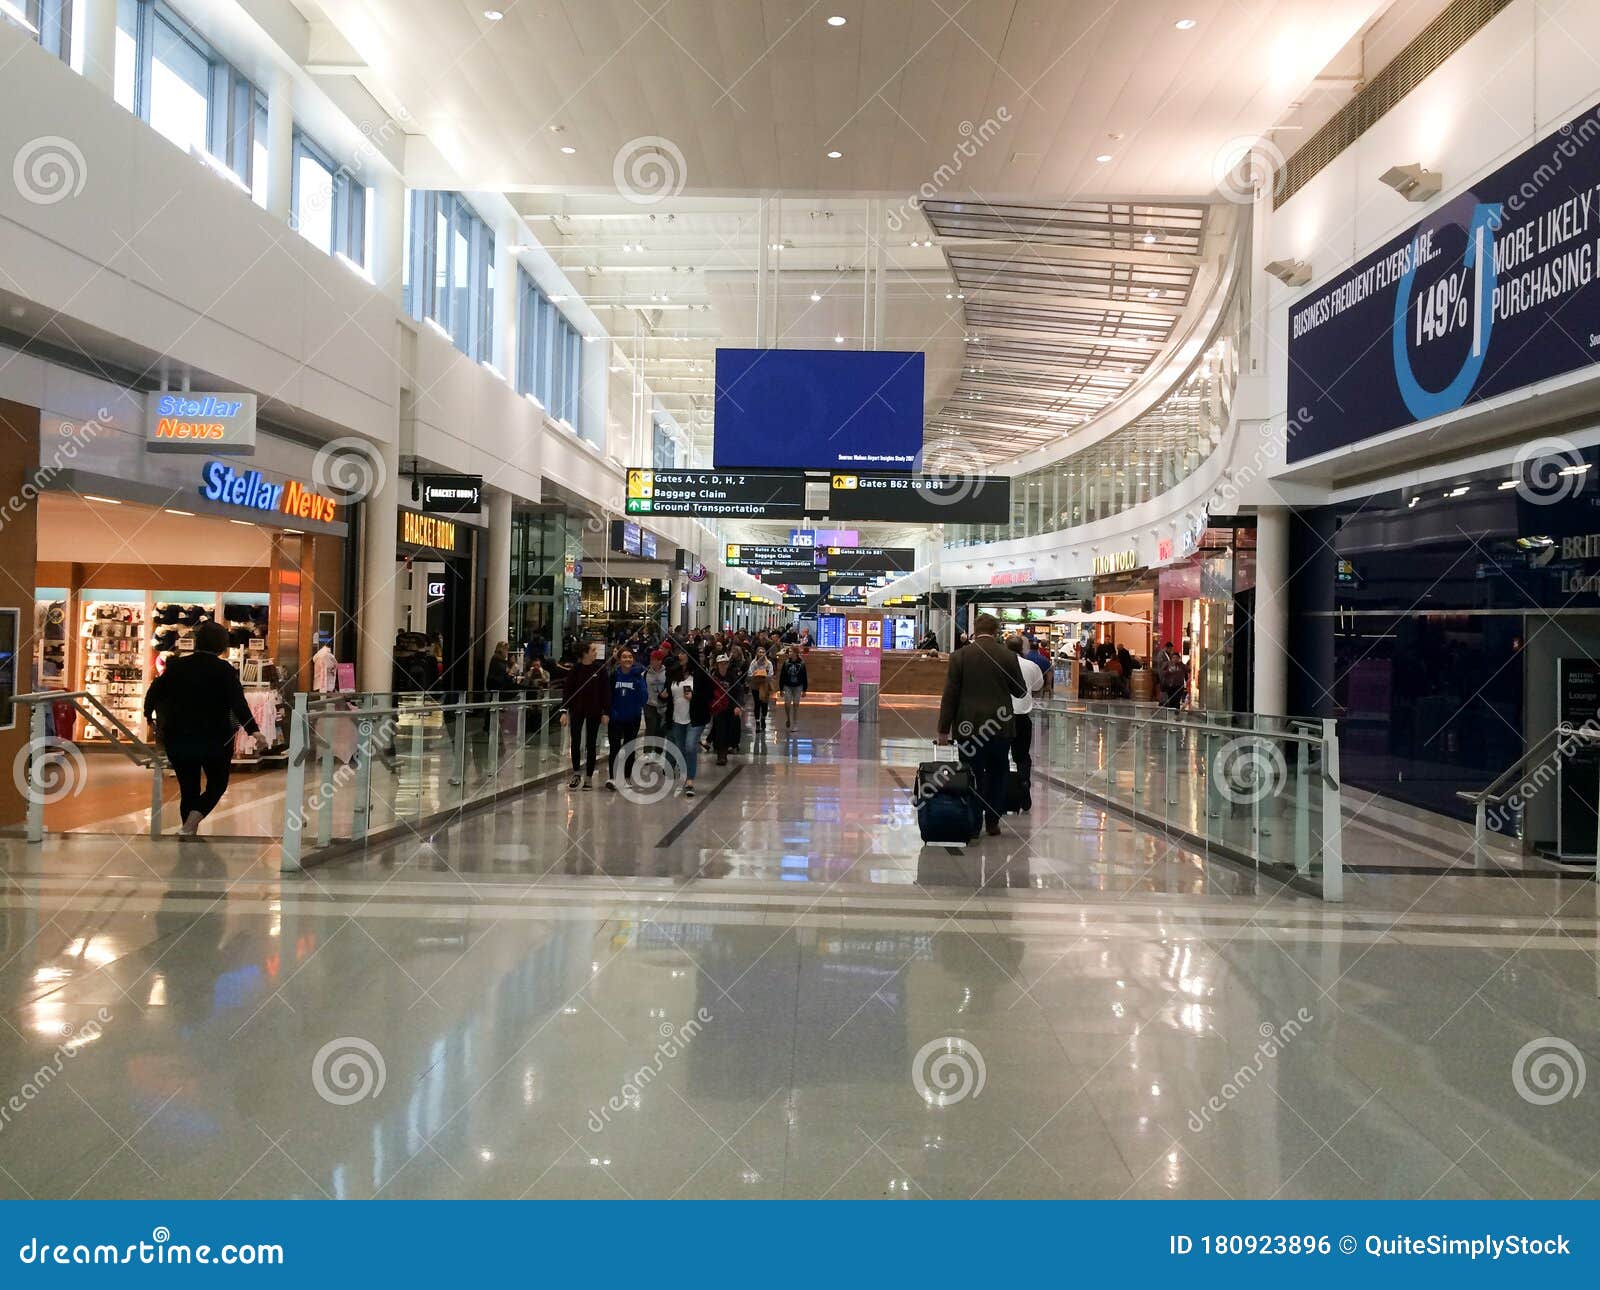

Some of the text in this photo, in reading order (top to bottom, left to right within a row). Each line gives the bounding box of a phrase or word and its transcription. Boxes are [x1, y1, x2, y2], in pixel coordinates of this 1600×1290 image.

[1493, 220, 1535, 277] MORE
[1538, 188, 1592, 254] LIKELY
[1293, 294, 1330, 340] BUSINESS
[1331, 265, 1376, 318] FREQUENT
[1376, 243, 1411, 291] FLYERS
[1491, 243, 1591, 325] PURCHASING
[1415, 267, 1468, 346] 149%
[157, 394, 242, 417] Stellar
[155, 418, 225, 439] News
[201, 460, 336, 523] Stellar News
[654, 489, 727, 499] Baggage Claim
[655, 475, 745, 485] Gates A, C, D, H, Z
[859, 480, 944, 489] Gates B62 to B81
[653, 503, 765, 513] Ground Transportation
[404, 511, 436, 547] BRACKET
